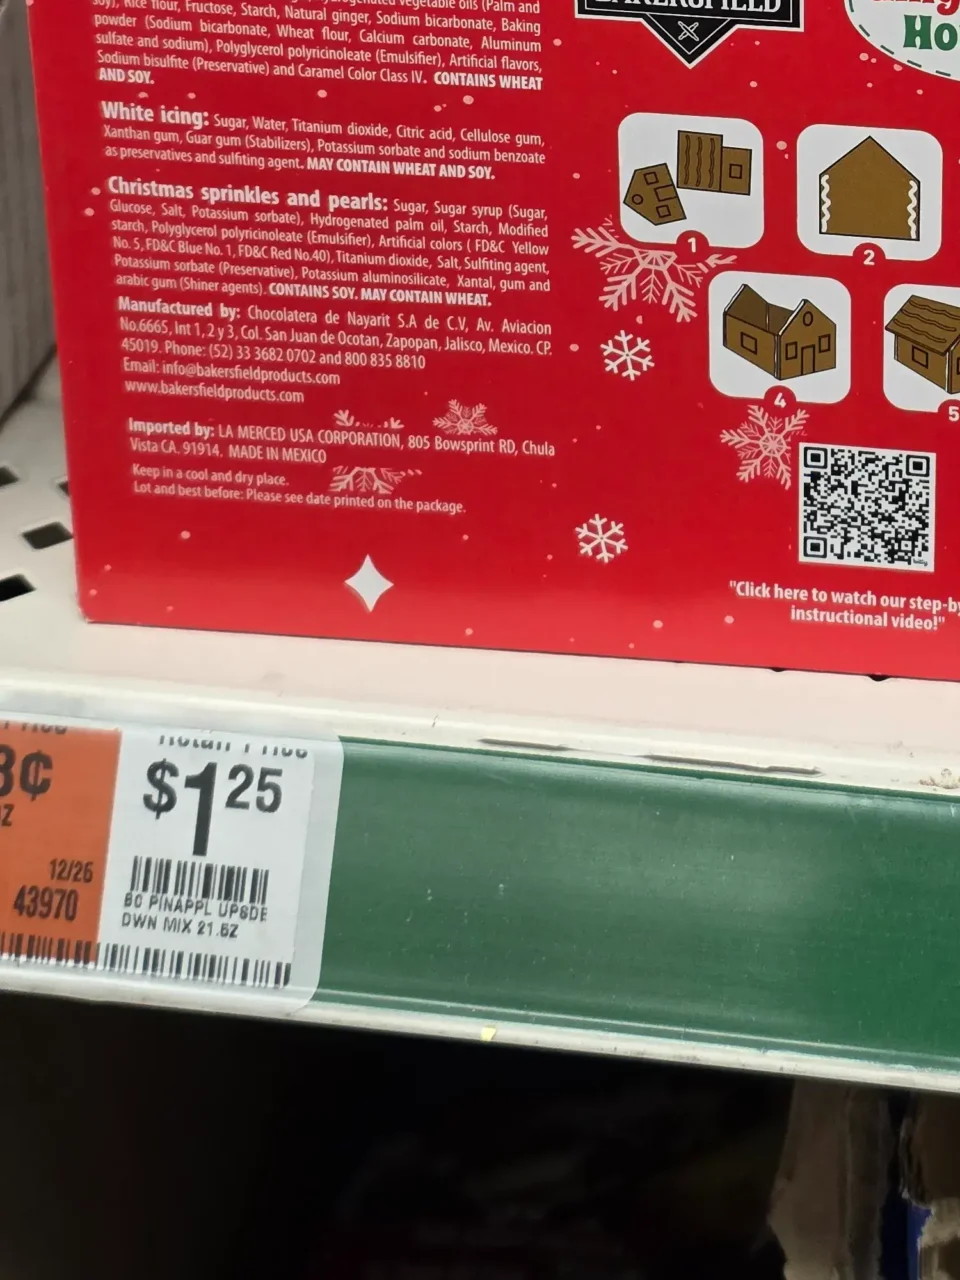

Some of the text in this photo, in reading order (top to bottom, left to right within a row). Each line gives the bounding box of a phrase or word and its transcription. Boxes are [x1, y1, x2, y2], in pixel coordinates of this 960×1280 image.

[98, 67, 154, 85] AND SOY.
[434, 71, 543, 90] CONTAINS WHEAT
[102, 100, 544, 148] White icing: Sugar, Water, Titanium dioxide, Citric acid, Cellulose gum,
[108, 175, 387, 212] Christmas sprinkles and pearls:
[688, 237, 696, 253] 1
[864, 249, 874, 266] 2
[118, 295, 240, 322] Manufactured by:
[123, 358, 340, 385] Email: info@bakersfieldproducts.com
[125, 380, 303, 403] www.bakersfieldproducts.com
[774, 392, 786, 408] 4
[949, 406, 959, 422] 5
[730, 580, 771, 598] "Click
[774, 583, 808, 602] here
[812, 587, 827, 603] to
[831, 590, 876, 606] watch
[880, 595, 906, 609] our
[791, 605, 944, 631] instructional video!"
[49, 858, 93, 883] 12/26
[13, 885, 78, 921] 43970
[122, 912, 157, 930] DWN
[163, 917, 192, 934] MIX
